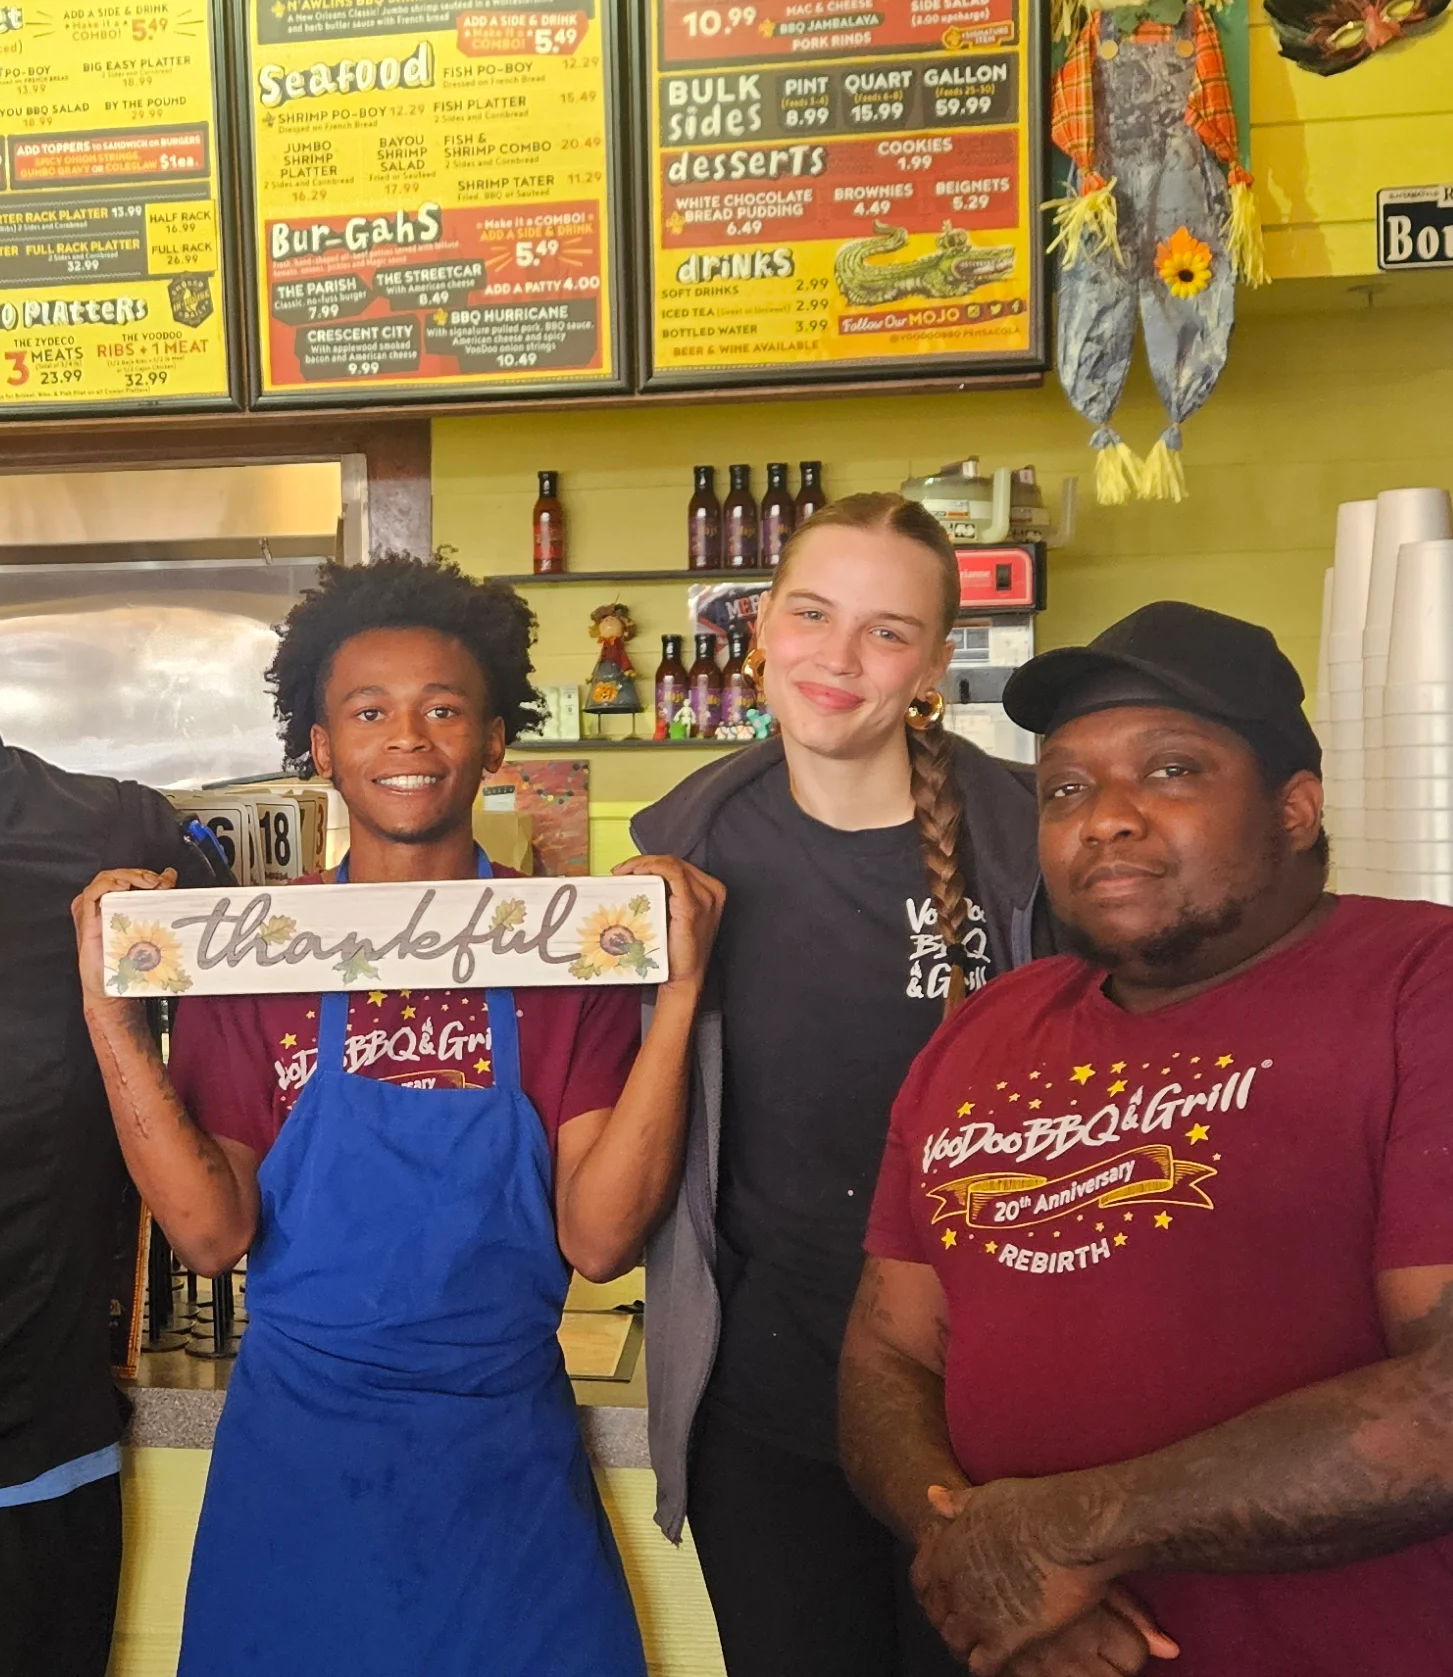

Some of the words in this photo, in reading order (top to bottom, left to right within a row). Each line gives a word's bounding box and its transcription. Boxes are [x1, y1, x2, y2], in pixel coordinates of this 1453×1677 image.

[683, 6, 757, 38] 10.99
[258, 40, 434, 108] Seafood
[845, 70, 913, 93] QUART
[923, 63, 1007, 87] GALLON
[669, 74, 762, 106] BULK
[785, 76, 829, 96] PINT
[433, 100, 462, 112] FISH
[467, 96, 526, 110] PLATTER
[560, 91, 596, 103] 15.49
[935, 96, 992, 117] 59.99
[278, 110, 328, 124] SHRIMP
[332, 107, 386, 120] PO-BOY
[389, 104, 425, 117] 12.29
[785, 107, 830, 127] 8.99
[851, 102, 904, 122] 15.99
[877, 136, 953, 156] COOKIES
[897, 155, 932, 171] 1.99
[834, 183, 914, 201] BROWNIES
[935, 177, 1010, 196] BEIGNETS
[676, 195, 720, 210] WHITE
[723, 188, 813, 206] CHOCOLATE
[853, 200, 891, 216] 4.49
[952, 194, 990, 211] 5.29
[25, 211, 57, 223] RACK
[59, 207, 108, 221] PLATTER
[111, 205, 142, 218] 13.99
[150, 212, 177, 224] HALF
[181, 210, 211, 221] RACK
[684, 208, 733, 223] BREAD
[737, 203, 803, 219] PUDDING
[166, 223, 196, 234] 16.99
[726, 219, 763, 235] 6.49
[151, 244, 180, 255] FULL
[182, 242, 212, 252] RACK
[167, 254, 198, 265] 26.99
[278, 285, 304, 299] THE
[307, 277, 357, 296] PARISH
[661, 288, 692, 299] SOFT
[694, 285, 739, 297] DRINKS
[795, 278, 829, 291] 2.99
[309, 304, 339, 320] 7.99
[451, 311, 481, 326] BBQ
[484, 305, 569, 322] HURRICANE
[842, 317, 884, 333] Follow
[884, 314, 907, 328] Our
[909, 308, 960, 326] MOJO
[307, 328, 379, 343] CRESCENT
[382, 325, 414, 338] CITY
[311, 345, 331, 354] With
[333, 342, 377, 353] applewood
[379, 341, 410, 350] smoked
[348, 362, 380, 375] 9.99
[496, 353, 537, 367] 10.49
[259, 811, 291, 866] 18
[172, 883, 581, 984] thankful
[994, 1194, 1032, 1222] 20th
[1033, 1159, 1136, 1215] Anniversary
[998, 1238, 1111, 1274] REBIRTH
